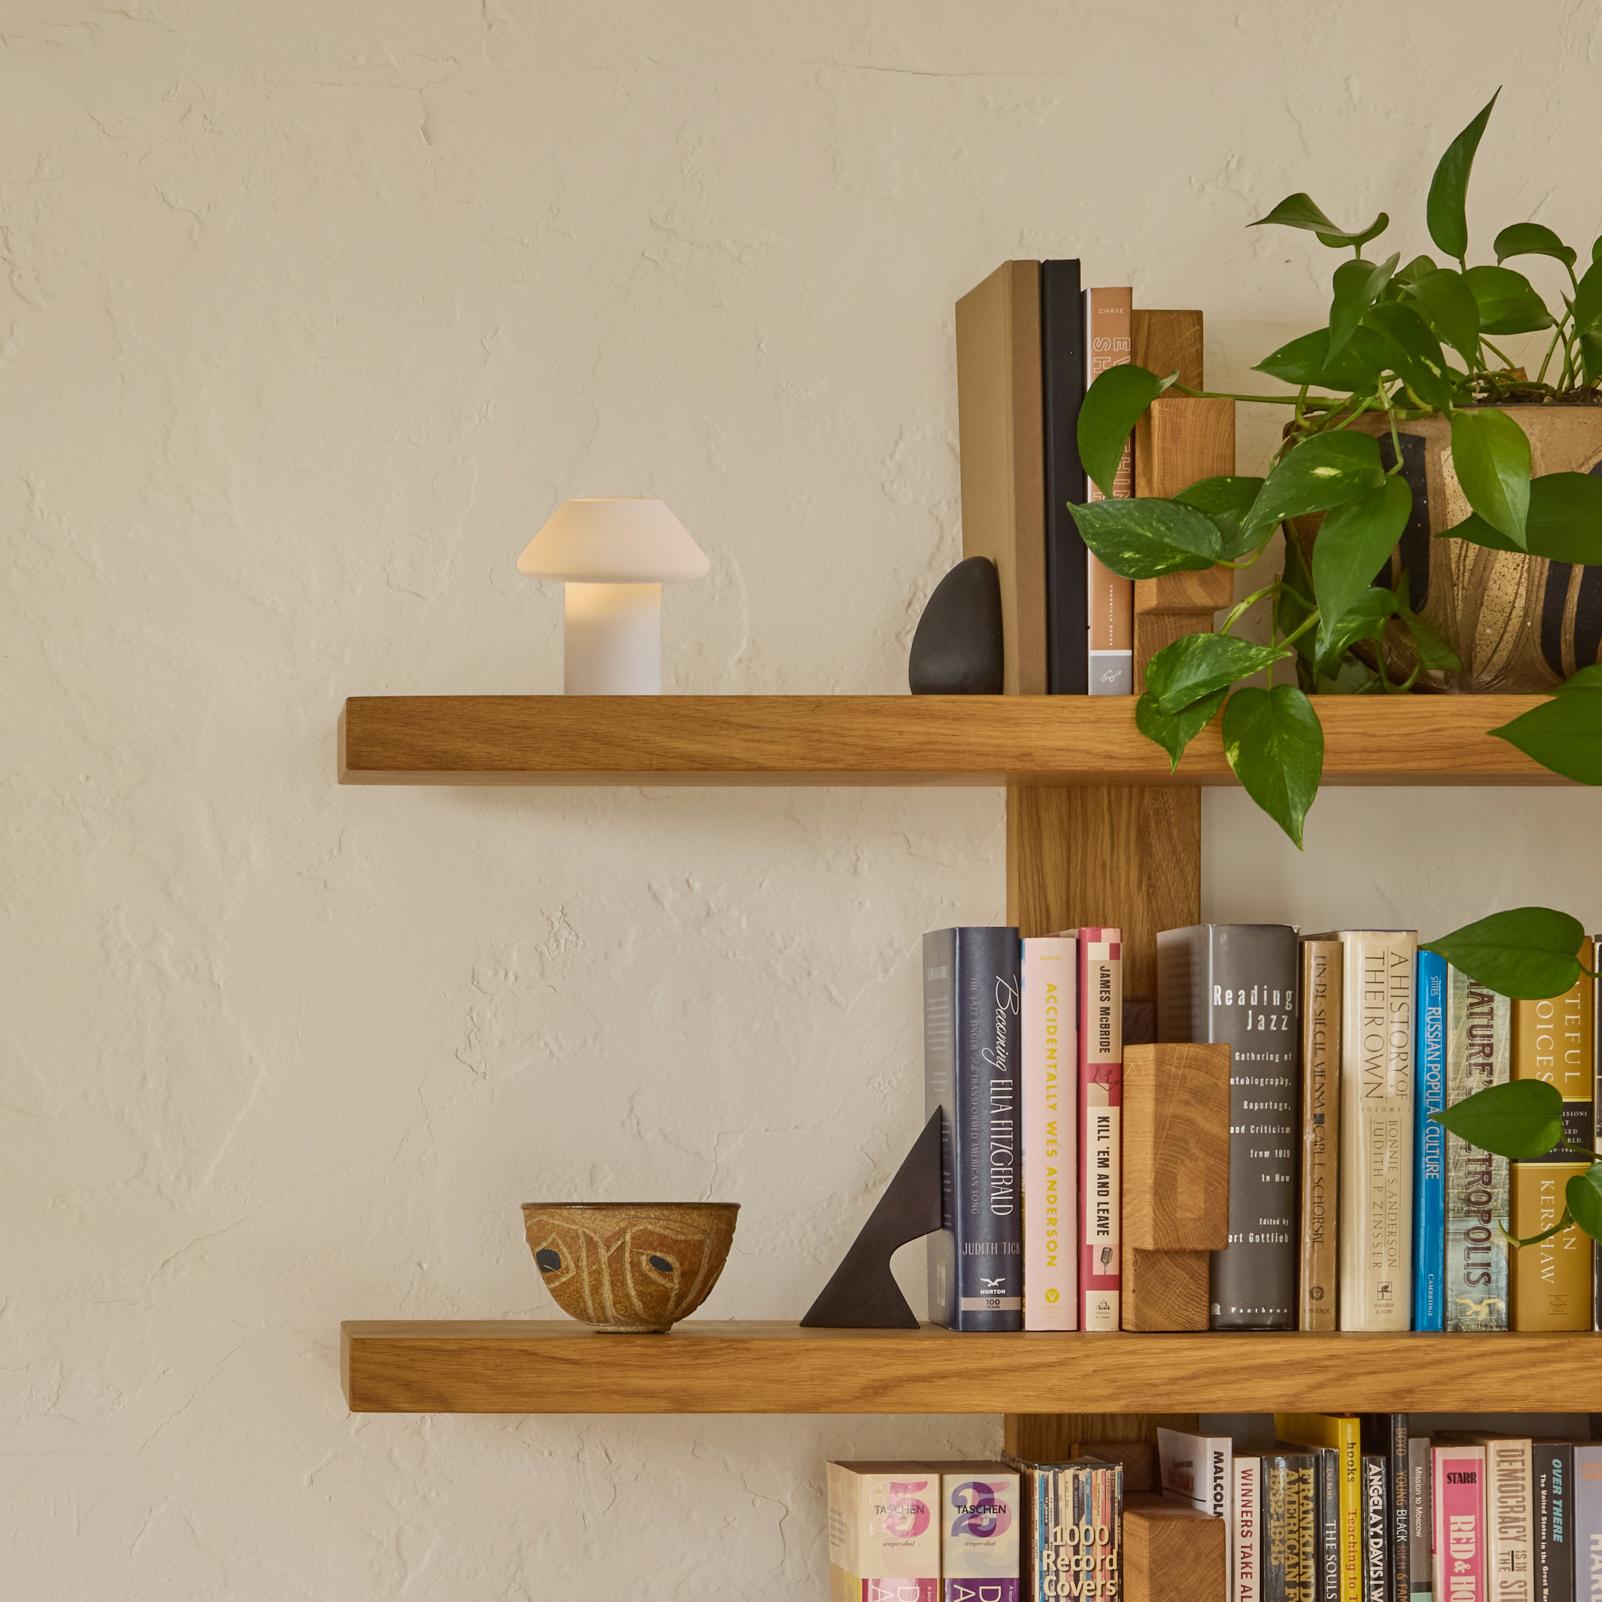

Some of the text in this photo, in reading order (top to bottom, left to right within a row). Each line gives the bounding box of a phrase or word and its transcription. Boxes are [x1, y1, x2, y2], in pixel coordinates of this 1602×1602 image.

[1099, 965, 1111, 1003] JAMES
[1213, 984, 1294, 1011] Reading
[1430, 975, 1441, 997] STITES
[1247, 1010, 1289, 1031] Jazz
[1363, 951, 1385, 1099] THEIR OWN
[1390, 951, 1410, 1101] A HISTORY OF
[1465, 974, 1495, 1099] ATURE'
[1235, 1051, 1292, 1063] Gathering of
[982, 974, 1020, 1216] Becoming ELLA FITZGERALD
[1229, 1076, 1292, 1087] utobiography,
[1424, 1006, 1442, 1180] RUSSIAN POPULA CULTURE
[1045, 982, 1058, 1267] ACCIDENTALLY WES ANDERSON
[1097, 1115, 1110, 1142] KILL
[1229, 1124, 1291, 1134] and Criticism
[1250, 1148, 1270, 1158] from
[1372, 1119, 1384, 1177] JUDITH
[1386, 1119, 1399, 1173] BONNIE
[1096, 1173, 1110, 1197] AND
[1261, 1174, 1291, 1182] to Now
[1096, 1201, 1110, 1237] LEAVE
[1259, 1217, 1289, 1227] Edited by
[1312, 1176, 1326, 1249] SCHORSKE
[1463, 1136, 1493, 1288] TROPOLIS
[1228, 1232, 1290, 1243] ert Gottlieb
[1372, 1201, 1384, 1269] ZINSSER
[1387, 1190, 1399, 1269] ANDERSON
[962, 1241, 998, 1256] JUDITH
[985, 1298, 1001, 1306] 100
[1231, 1306, 1288, 1314] Pantheon
[1395, 1427, 1407, 1457] BOYD
[1346, 1441, 1356, 1483] hooks
[1446, 1472, 1477, 1485] STARR
[1240, 1468, 1253, 1538] WINNERS
[1396, 1471, 1409, 1506] YOUNG
[1415, 1466, 1423, 1538] Mission to Moscow
[1551, 1458, 1563, 1543] OVER THERE
[874, 1505, 925, 1514] TASCHEN
[956, 1504, 1007, 1514] TASCHEN
[1270, 1469, 1285, 1566] 1932-1945
[1285, 1469, 1300, 1583] AMERICAN
[1299, 1468, 1315, 1583] FRANKLIN
[1396, 1509, 1409, 1543] BLACK
[1496, 1448, 1527, 1573] DEMOCRACY IS IN THE
[1053, 1524, 1110, 1547] 1000
[1346, 1508, 1358, 1572] Teaching
[1450, 1515, 1476, 1560] RED
[1541, 1542, 1547, 1550] in
[1042, 1549, 1118, 1572] Record
[1240, 1545, 1253, 1580] TAKE
[1325, 1519, 1338, 1600] THE SOULS
[1369, 1538, 1384, 1578] DAVIS
[1453, 1560, 1472, 1573] &
[1044, 1575, 1117, 1598] Covers
[1348, 1575, 1358, 1589] to
[1397, 1573, 1408, 1581] &
[1541, 1566, 1549, 1586] Great
